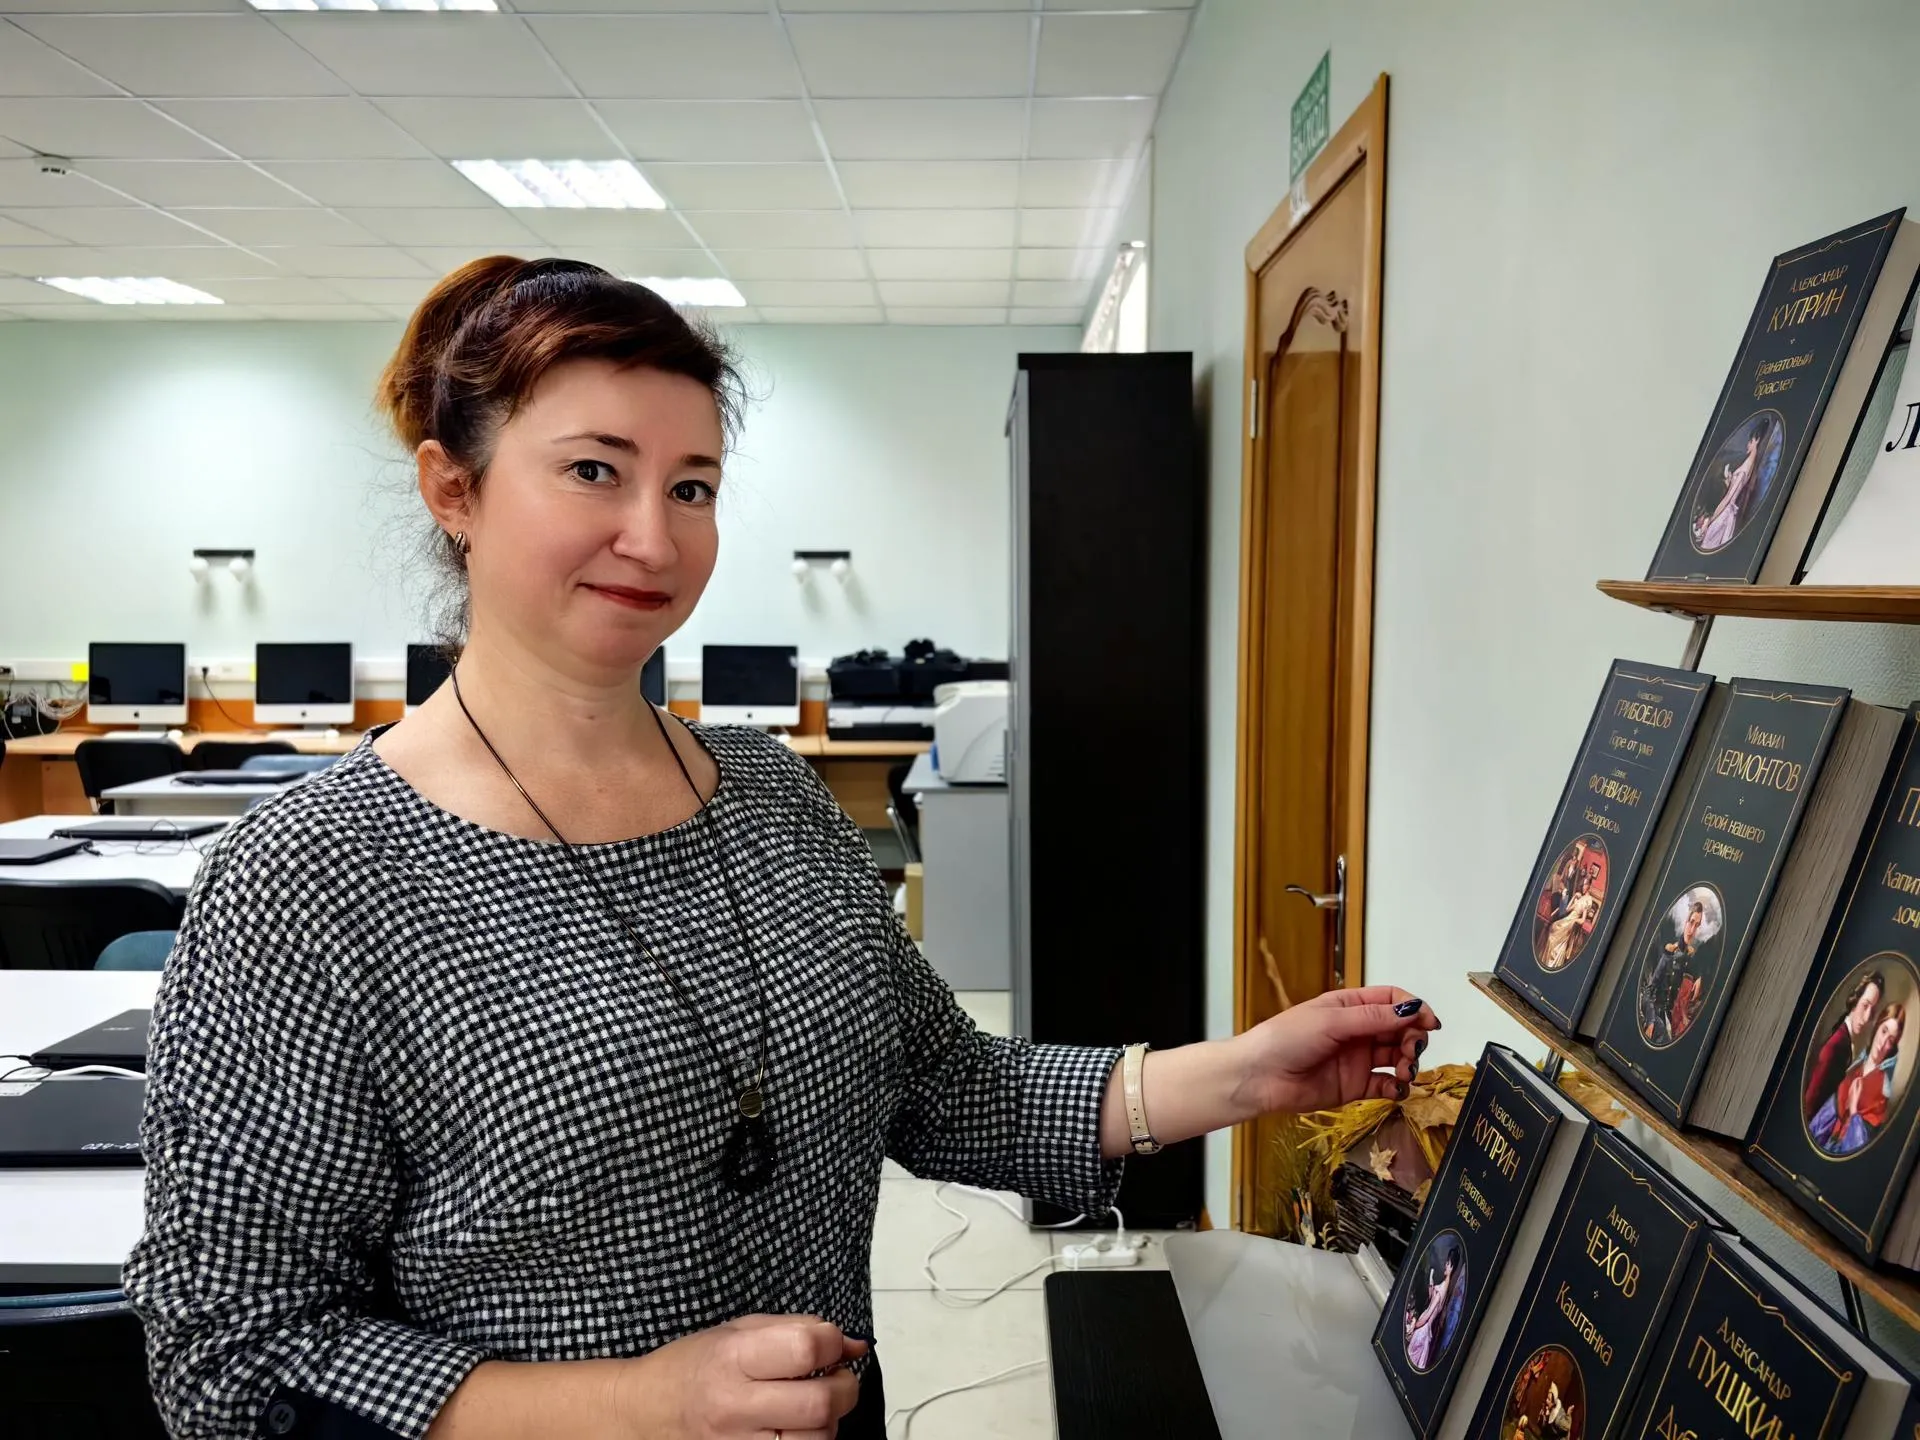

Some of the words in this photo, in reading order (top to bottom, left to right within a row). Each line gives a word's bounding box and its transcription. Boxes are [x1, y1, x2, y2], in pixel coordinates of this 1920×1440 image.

[1790, 265, 1848, 293] АЛЕКСАНДР
[1767, 284, 1847, 333] КУПРИН
[1613, 699, 1674, 728] ГРИБОЕДОВ
[1627, 740, 1638, 752] от
[1745, 724, 1786, 750] МИХАИЛ
[1589, 773, 1642, 807] ФОНВИЗИН
[1711, 748, 1802, 792] ЛЕРМОНТОВ
[1701, 805, 1729, 831] Герой
[1727, 819, 1766, 844] нашего
[1703, 838, 1744, 864] времени
[1489, 1095, 1525, 1140] АЛЕКСАНДР
[1472, 1113, 1520, 1182] КУПРИН
[1459, 1168, 1495, 1221] Гранатовый
[1606, 1204, 1640, 1248] АНТОН
[1586, 1219, 1640, 1299] ЧЕХОВ
[1556, 1281, 1613, 1367] Каштанка
[1717, 1316, 1792, 1400] АЛЕКСАНДР
